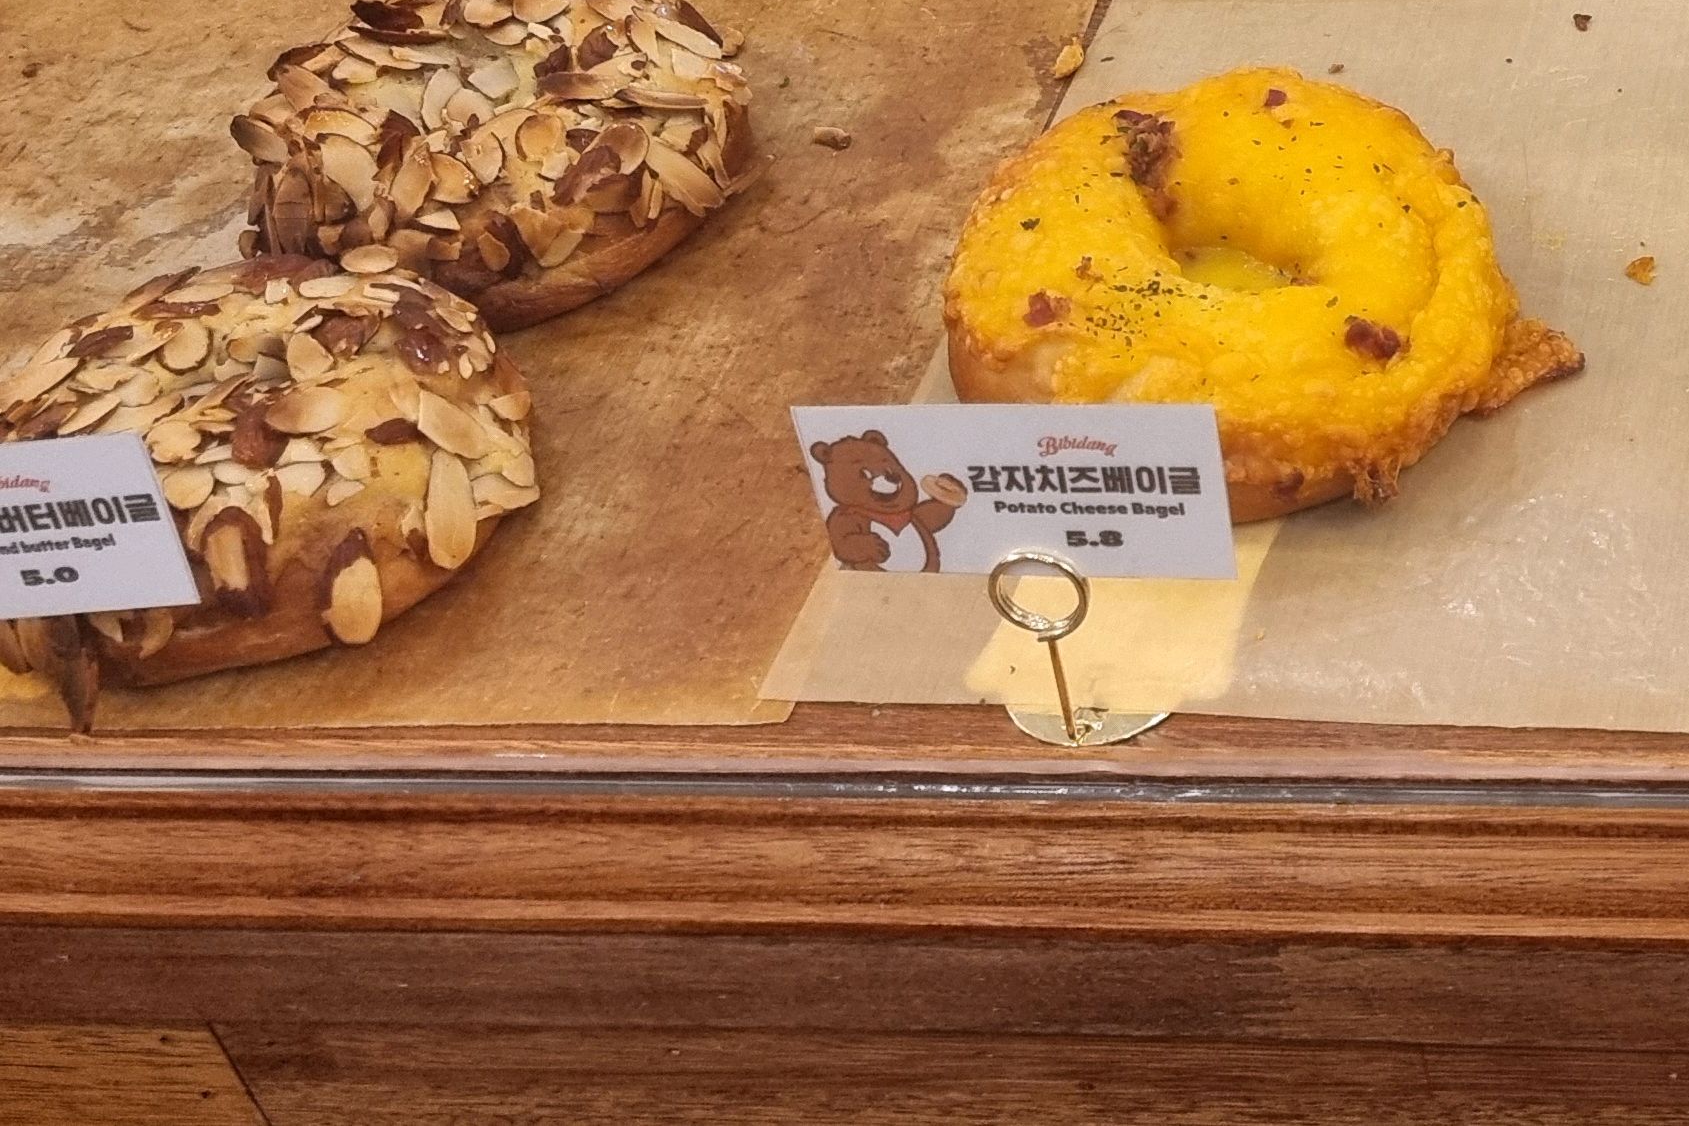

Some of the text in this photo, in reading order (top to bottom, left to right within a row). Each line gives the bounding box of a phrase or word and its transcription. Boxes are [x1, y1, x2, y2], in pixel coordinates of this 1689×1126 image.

[1037, 435, 1118, 458] Bibidang
[966, 464, 1202, 495] 감자치즈베이글
[993, 500, 1187, 519] Potato Cheese Bagel
[19, 539, 70, 554] butter
[70, 533, 117, 552] Bagel
[1065, 530, 1124, 547] 5.8
[19, 566, 80, 587] 5.0
